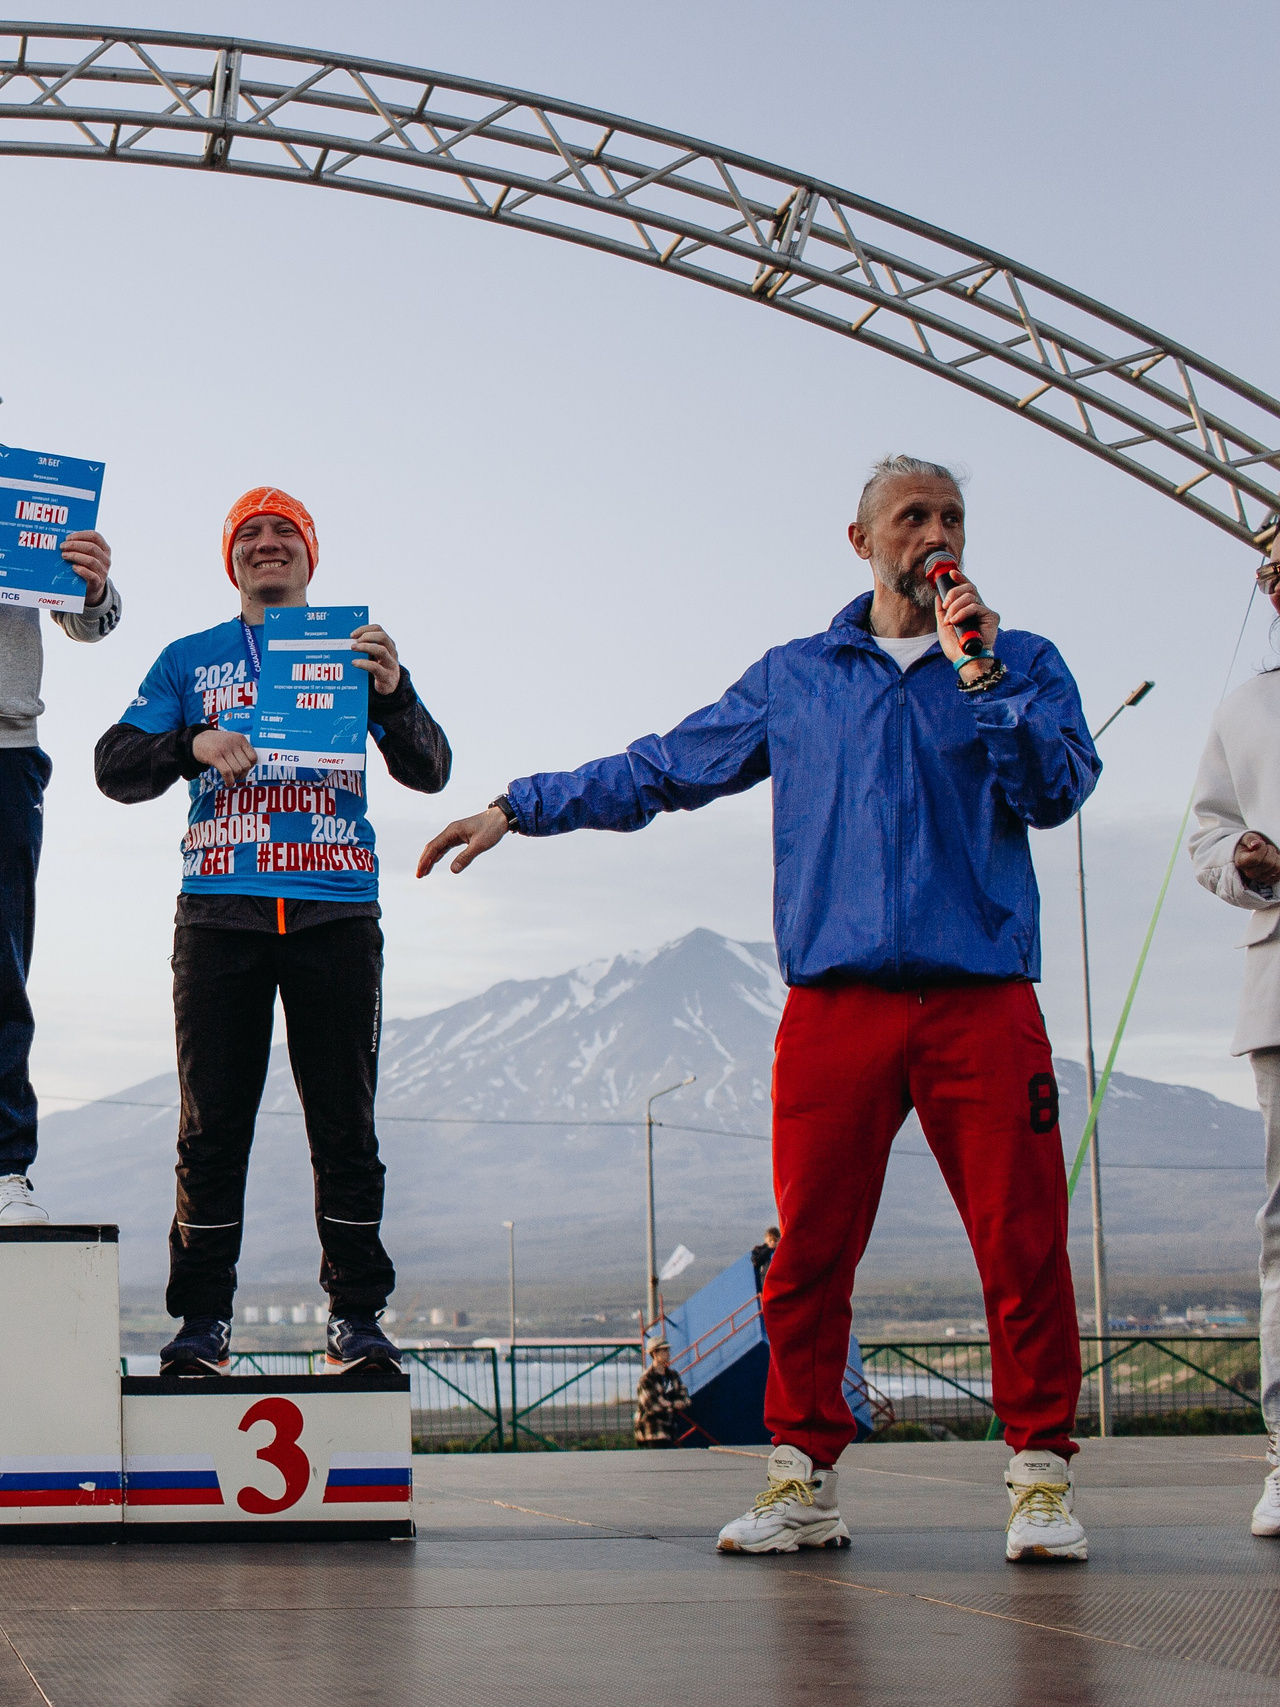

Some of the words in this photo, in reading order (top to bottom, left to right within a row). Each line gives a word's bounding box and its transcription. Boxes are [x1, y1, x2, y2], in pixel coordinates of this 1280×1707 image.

[21, 501, 69, 525] МЕСТО
[18, 530, 41, 550] 21,1
[39, 532, 58, 551] КМ
[1, 591, 20, 601] ПСБ
[38, 597, 65, 606] FONBET
[244, 628, 261, 673] САХАЛИНСКАЯ
[194, 659, 247, 694] 2024
[304, 663, 344, 682] МЕСТО
[202, 681, 258, 717] #МЕЧ
[296, 693, 317, 711] 21,1
[316, 693, 334, 709] КМ
[280, 754, 299, 762] ПСБ
[214, 785, 337, 817] #ГОРДОСТЬ
[311, 815, 360, 846] 2024
[257, 842, 376, 874] #ЕДИНСТВО
[1028, 1072, 1059, 1134] 8
[236, 1397, 311, 1515] 3
